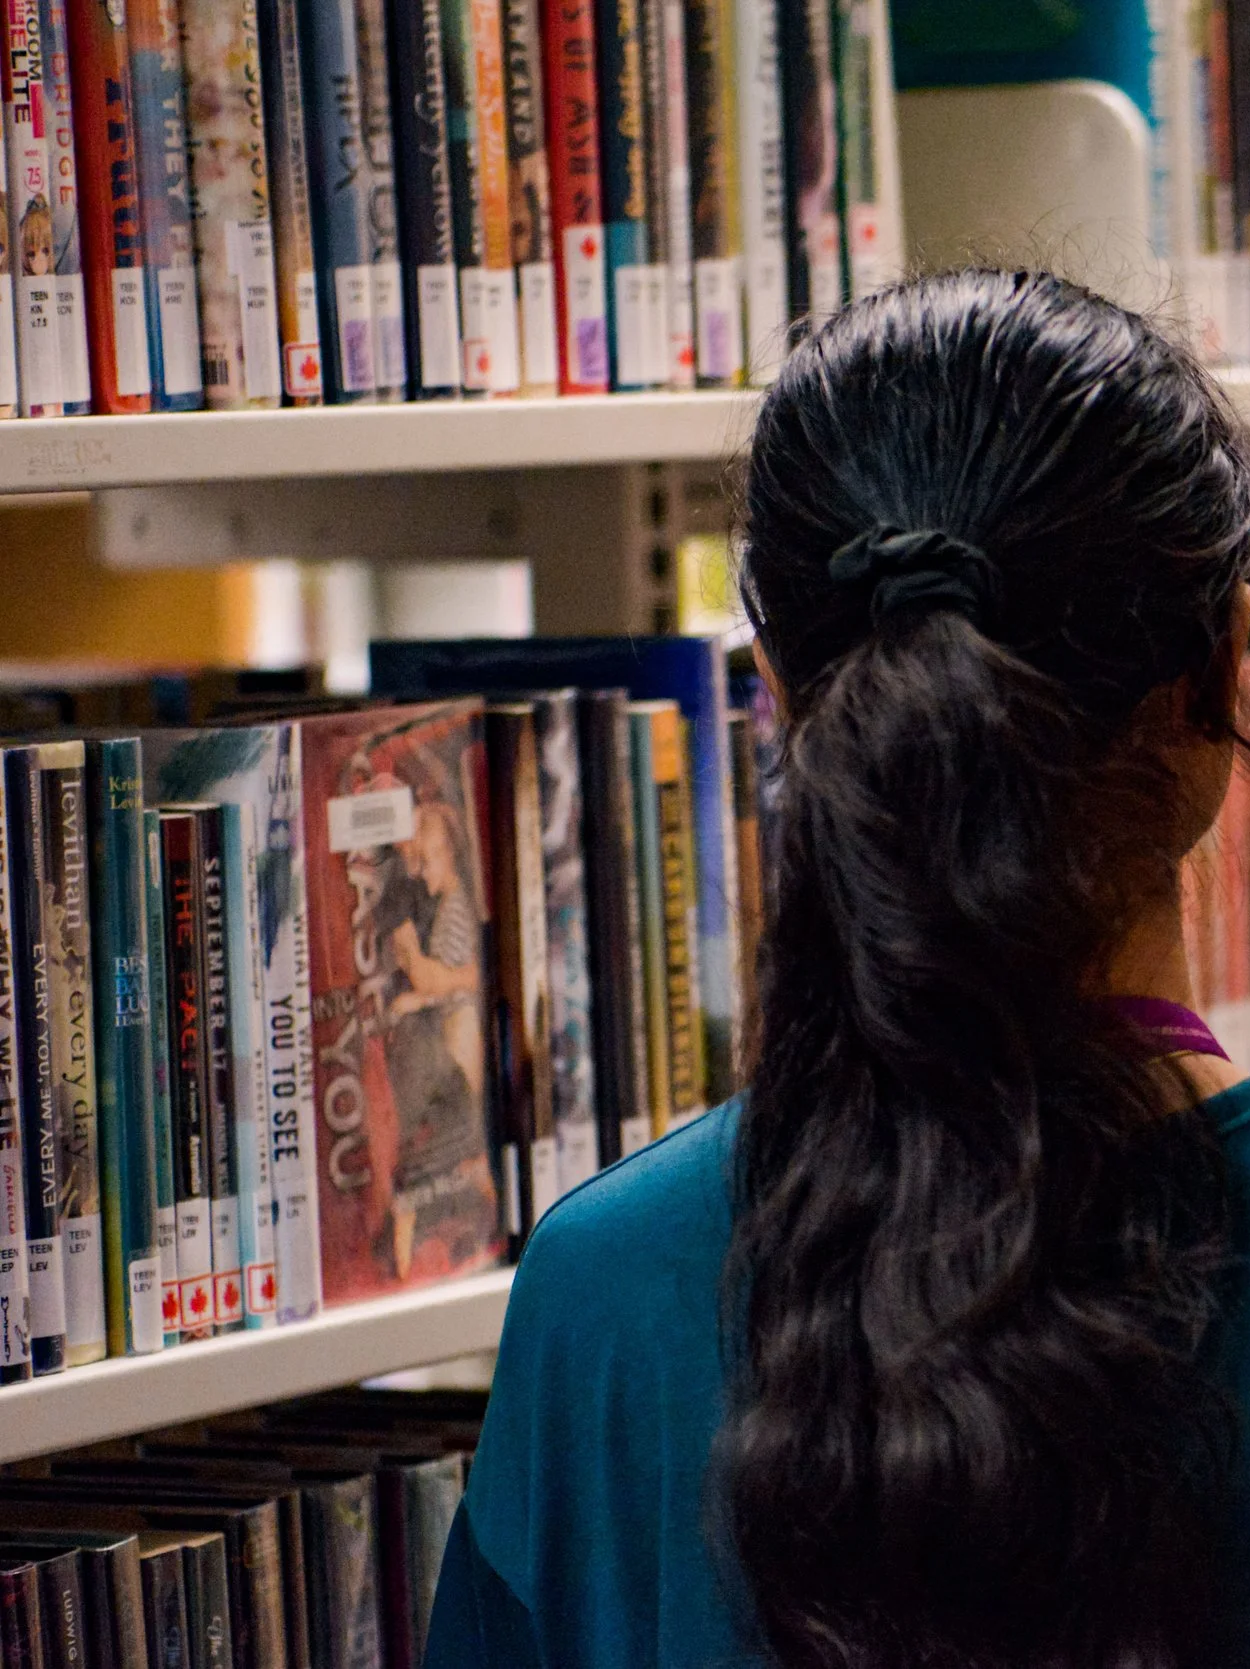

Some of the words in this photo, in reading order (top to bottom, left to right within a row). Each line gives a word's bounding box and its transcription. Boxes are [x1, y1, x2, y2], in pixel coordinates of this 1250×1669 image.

[10, 28, 31, 123] ELITE
[30, 290, 49, 301] TEEN
[61, 778, 85, 930] levithan
[204, 858, 226, 1029] SEPTEMBER
[33, 943, 51, 1020] EVERY
[63, 990, 88, 1089] every
[270, 994, 296, 1049] YOU
[38, 1031, 52, 1084] YOU,
[212, 1049, 227, 1070] 17
[272, 1063, 298, 1099] TO
[40, 1089, 53, 1120] ME
[320, 1018, 371, 1191] YOU
[66, 1099, 93, 1167] day
[273, 1110, 299, 1163] SEE
[40, 1128, 57, 1208] EVERY
[29, 1243, 53, 1255] TEEN
[68, 1229, 92, 1241] TEEN
[69, 1242, 87, 1254] LEV
[29, 1261, 49, 1273] LEV
[62, 1589, 78, 1662] LUDWIG
